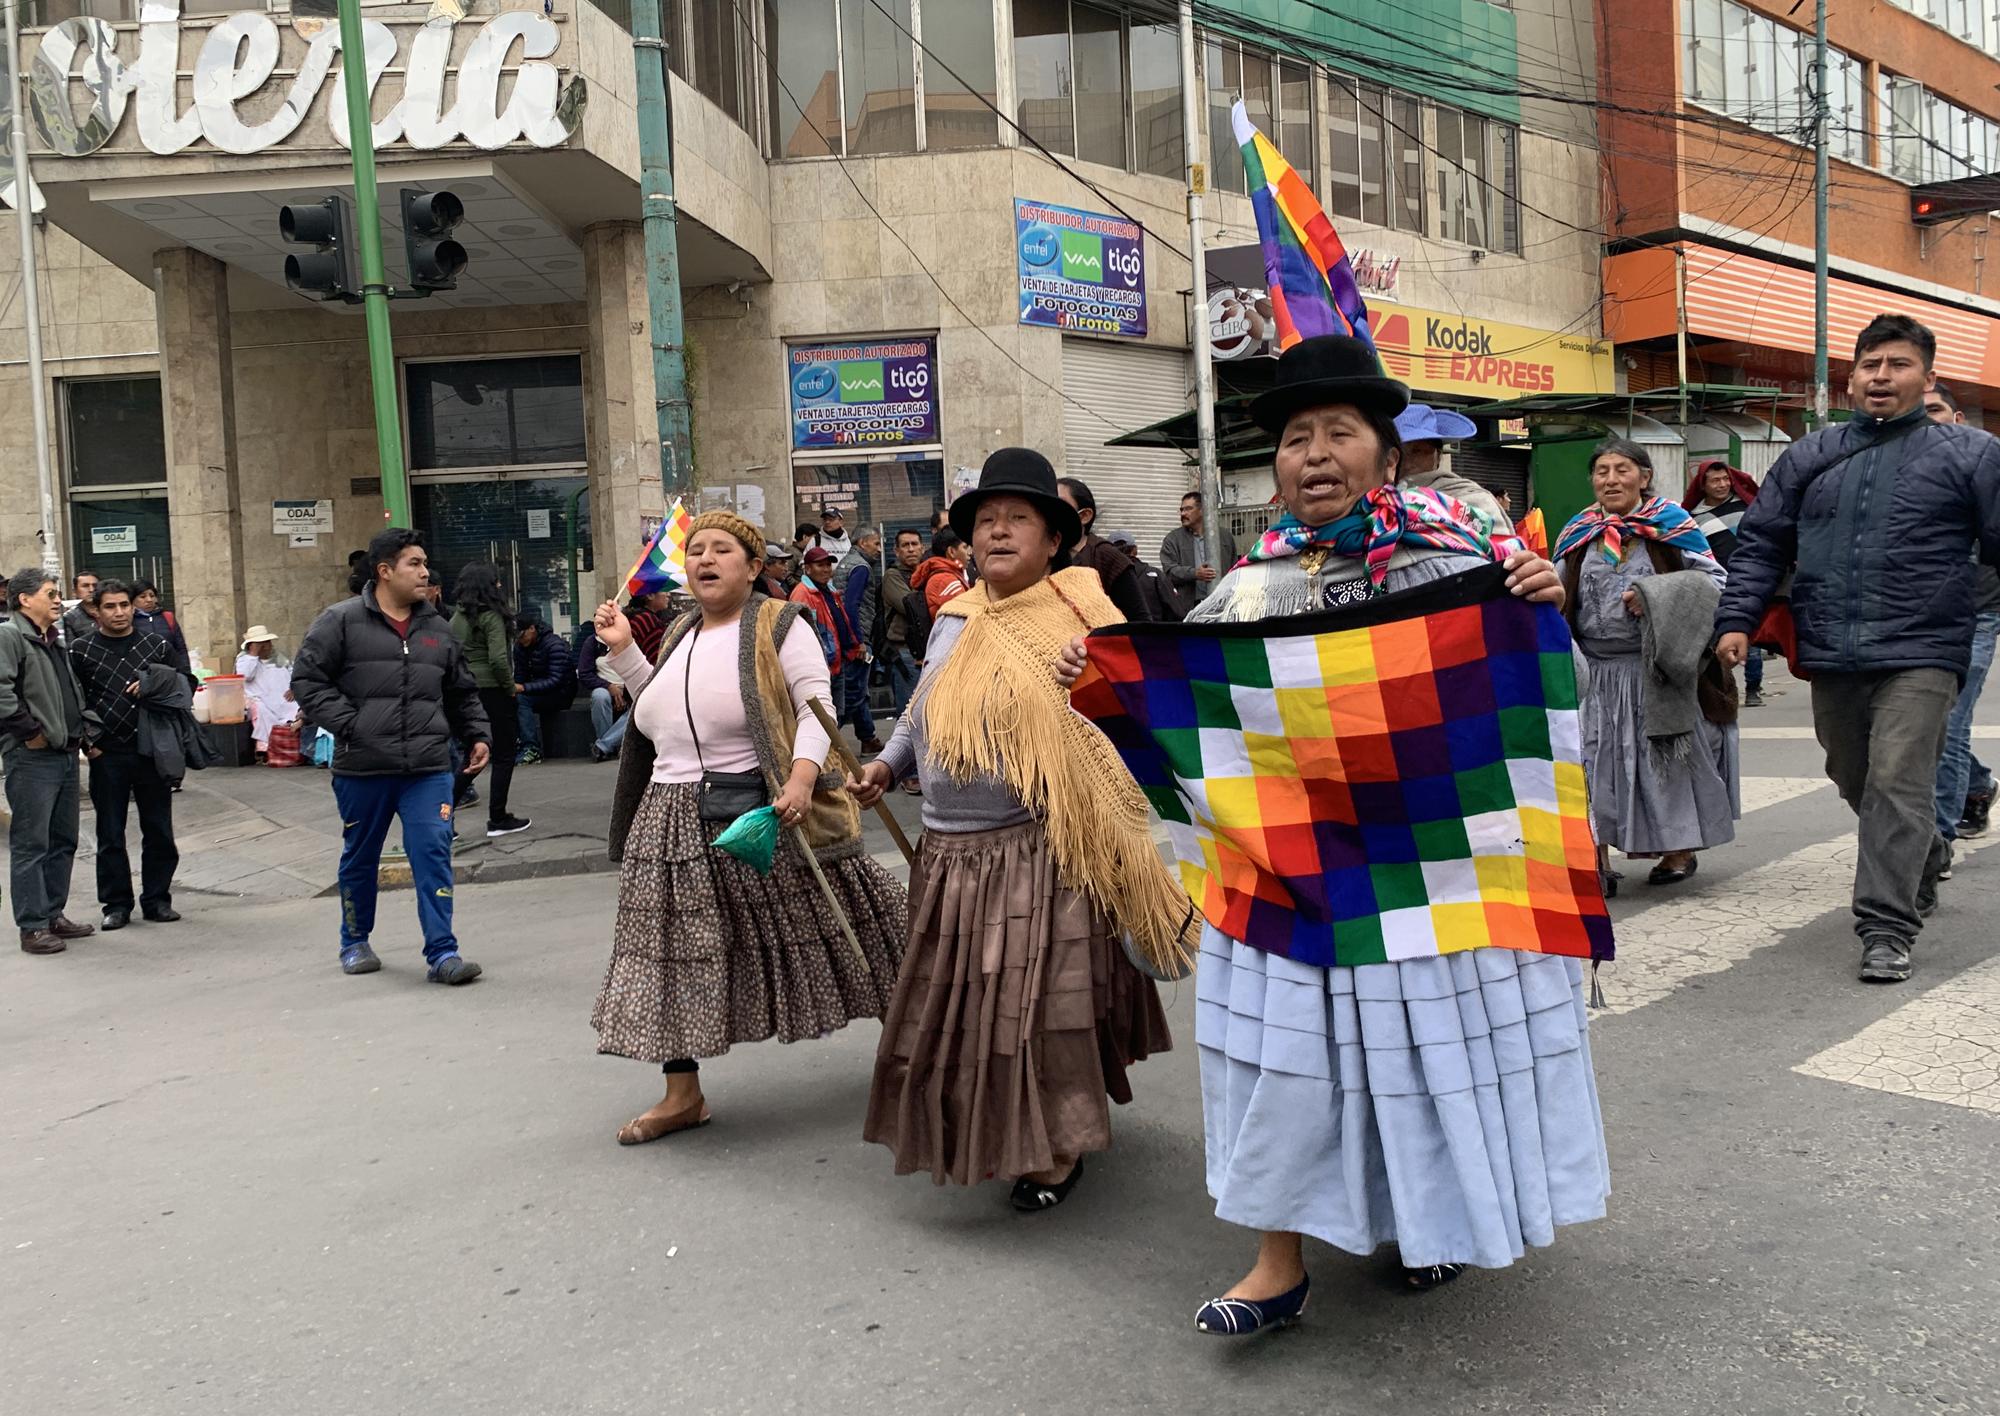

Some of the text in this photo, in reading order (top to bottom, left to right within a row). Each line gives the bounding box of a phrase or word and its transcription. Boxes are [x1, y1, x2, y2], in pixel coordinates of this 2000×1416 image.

[1020, 205, 1140, 240] DISTRIBUIDOR AUTORIZADO
[1024, 243, 1048, 257] entel
[1022, 278, 1142, 306] VENTA DE TARJETAS Y RECARGAS
[1034, 296, 1138, 320] FOTOCOPIAS
[1079, 318, 1121, 332] FOTOS
[1426, 317, 1493, 355] Kodak
[794, 342, 927, 364] DISTRIBUIDOR AUTORIZADO
[1448, 351, 1555, 392] EXPRESS
[799, 379, 824, 391] entel
[797, 402, 929, 421] VENTA DE TARJETAS Y RECARGAS
[809, 416, 925, 434] FOTOCOPIAS
[858, 431, 904, 442] FOTOS
[287, 509, 316, 518] ODAJ
[103, 533, 126, 541] ODAJ
